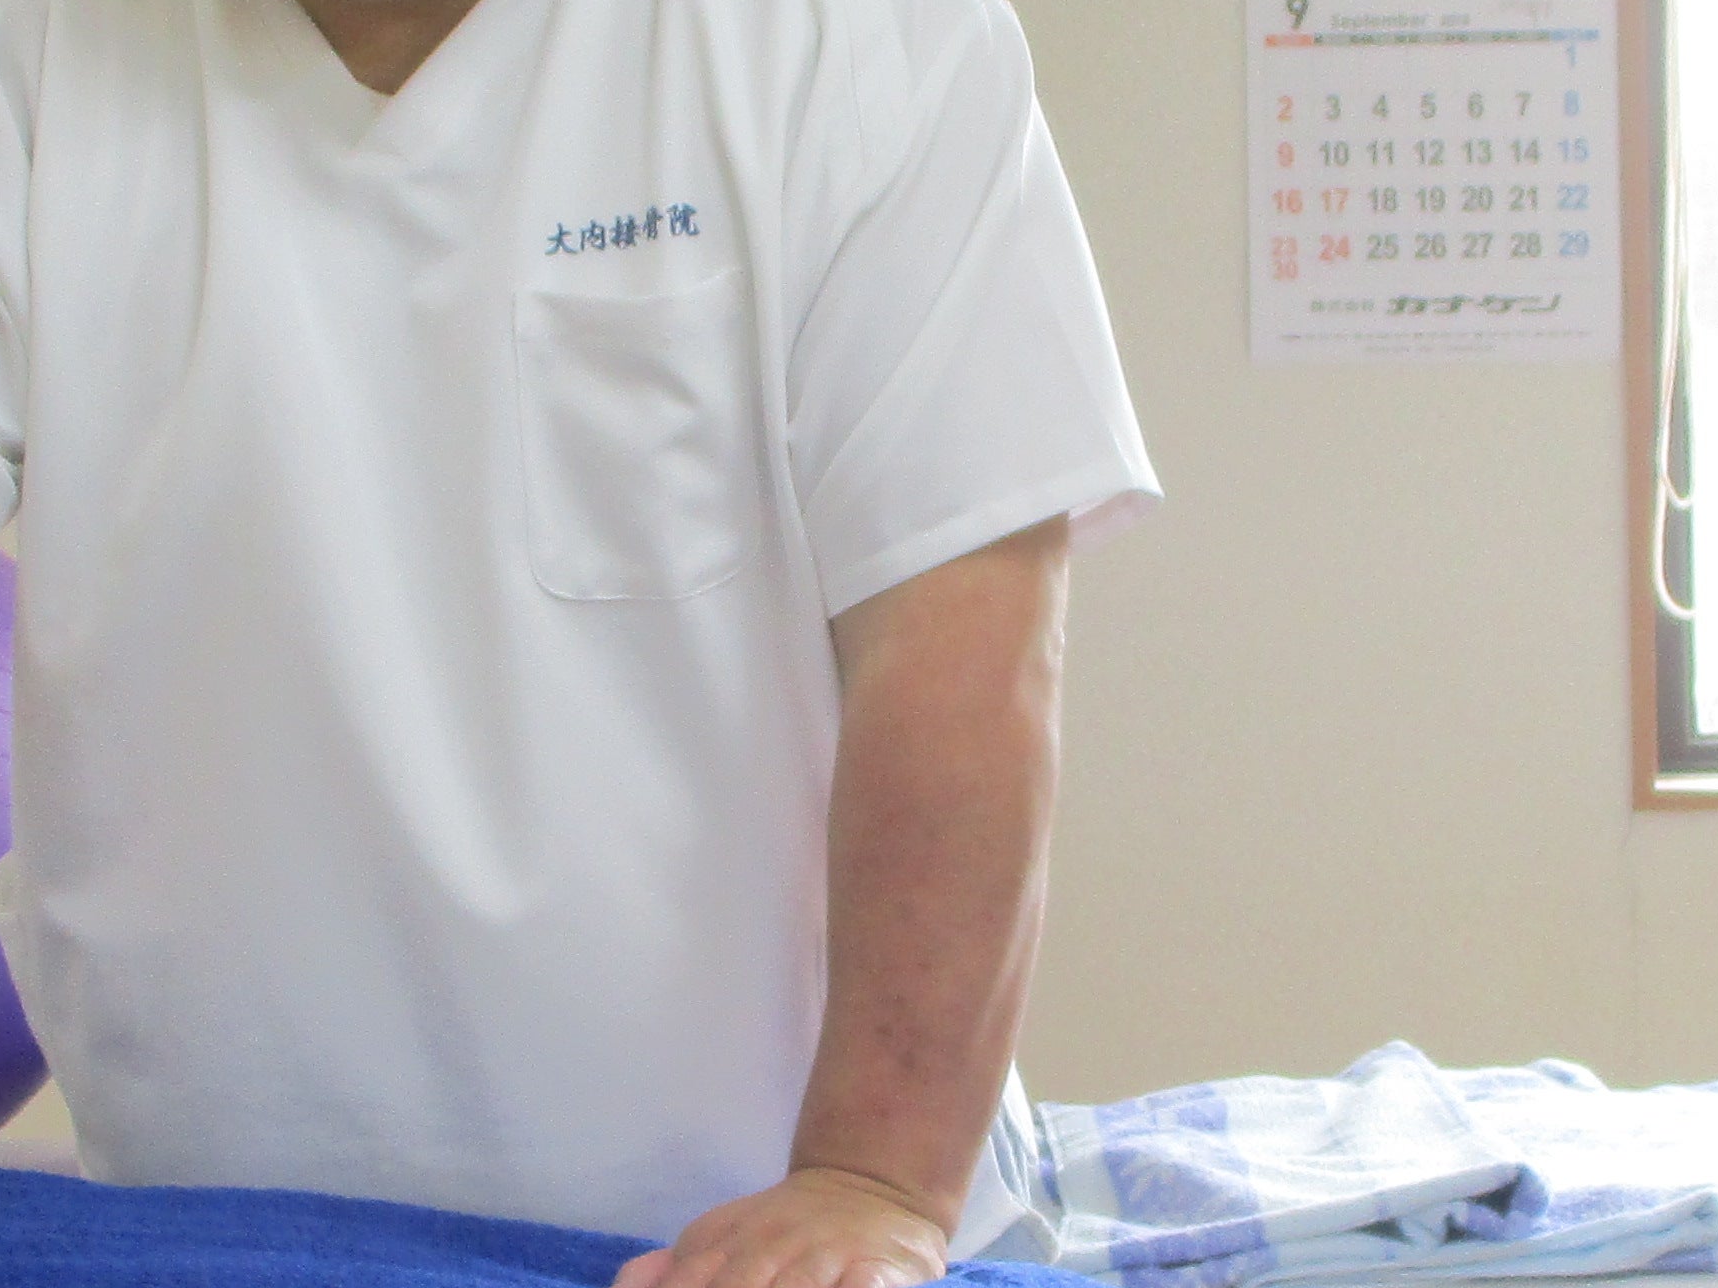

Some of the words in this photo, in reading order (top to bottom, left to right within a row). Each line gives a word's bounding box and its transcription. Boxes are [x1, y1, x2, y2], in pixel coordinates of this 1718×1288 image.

[1567, 43, 1577, 68] 1
[1277, 95, 1294, 121] 2
[1326, 93, 1341, 120] 3
[1372, 93, 1389, 119] 4
[1420, 92, 1437, 119] 5
[1468, 92, 1484, 118] 6
[1515, 91, 1532, 117] 7
[1564, 90, 1579, 117] 8
[1278, 142, 1295, 168] 9
[1319, 140, 1349, 167] 10
[1367, 140, 1395, 166] 11
[1414, 139, 1445, 165] 12
[1461, 138, 1492, 164] 13
[1510, 138, 1542, 164] 14
[1558, 138, 1589, 164] 15
[1272, 189, 1303, 215] 16
[1321, 188, 1349, 214] 17
[1368, 187, 1397, 213] 18
[1416, 186, 1446, 212] 19
[1461, 185, 1493, 212] 20
[1510, 185, 1539, 211] 21
[1558, 184, 1589, 211] 22
[544, 202, 700, 255] 大内接骨院
[1271, 235, 1298, 259] 23
[1319, 235, 1351, 261] 24
[1367, 234, 1399, 260] 25
[1414, 233, 1446, 259] 26
[1462, 233, 1494, 259] 27
[1510, 232, 1542, 258] 28
[1559, 231, 1590, 257] 29
